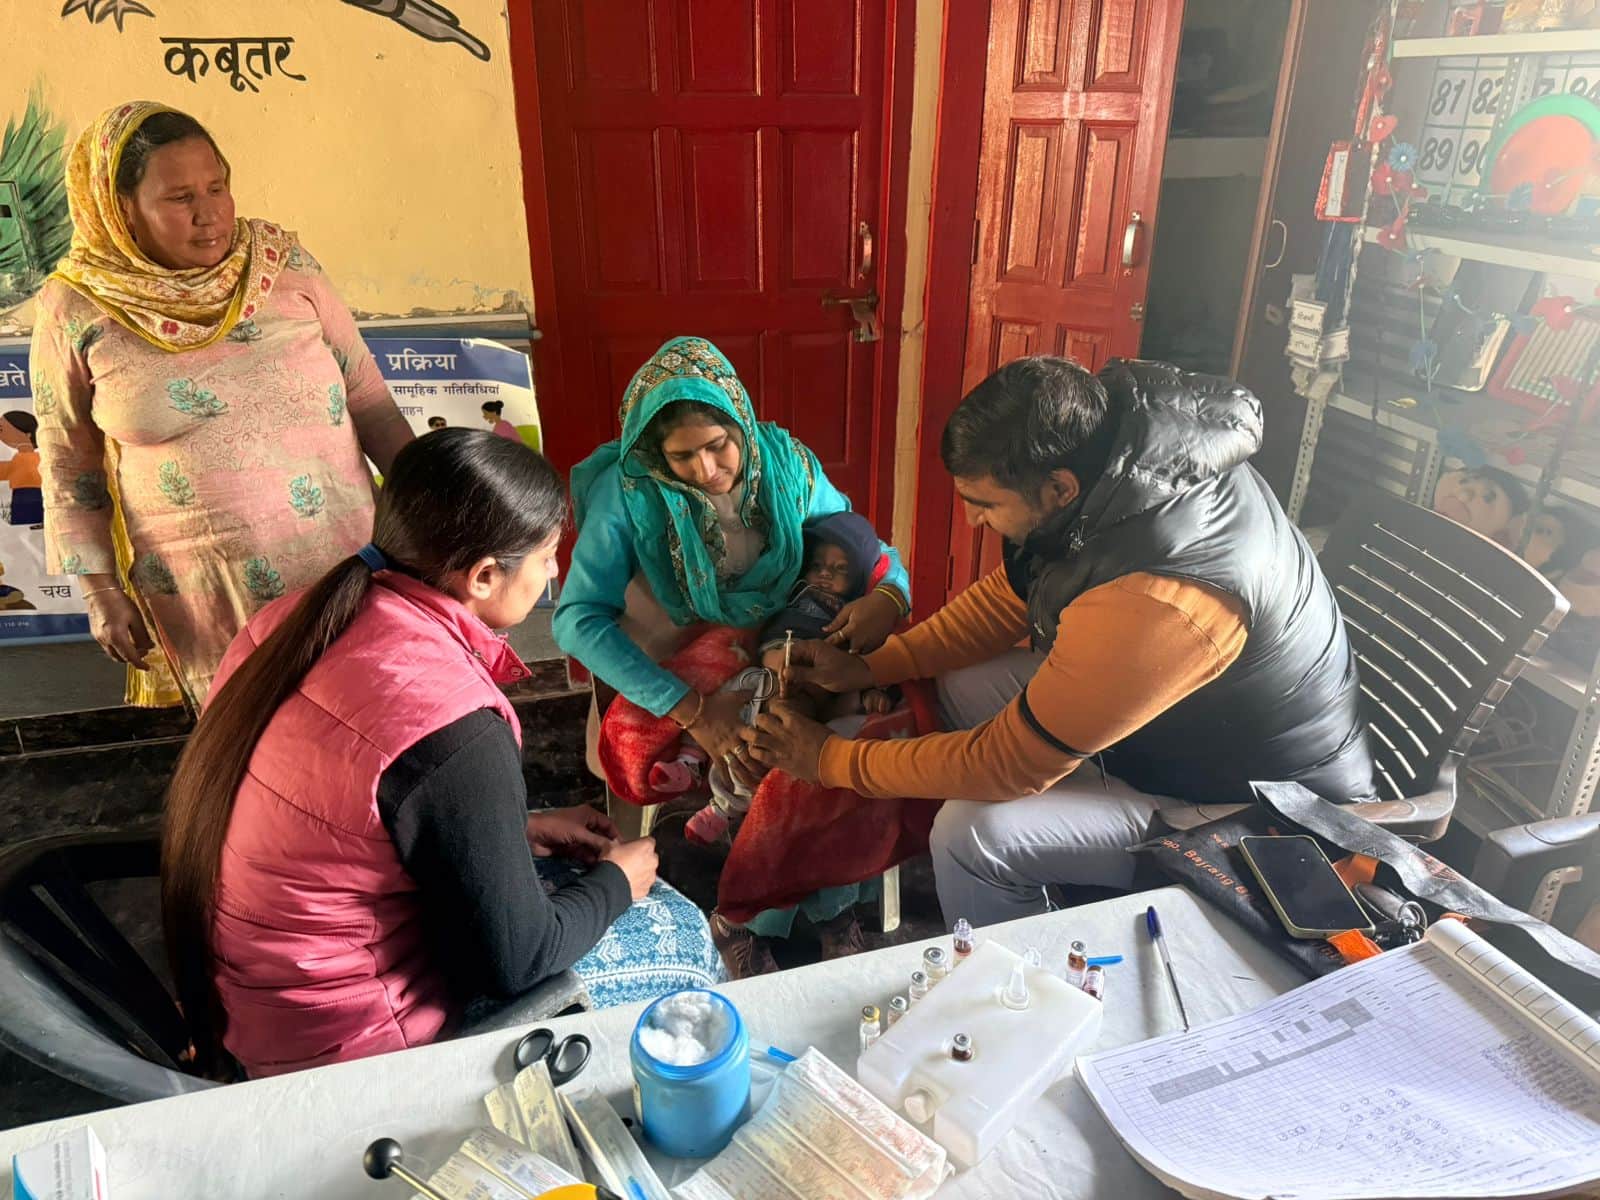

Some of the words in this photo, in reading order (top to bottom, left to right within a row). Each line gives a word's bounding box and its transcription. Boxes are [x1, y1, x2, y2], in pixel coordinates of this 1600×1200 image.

[159, 37, 306, 93] कबूतर
[1431, 78, 1466, 116] 81
[1419, 137, 1454, 171] 89
[385, 347, 457, 371] प्रक्रिया
[393, 383, 437, 398] सामूहिक
[1183, 849, 1235, 887] Bajrang
